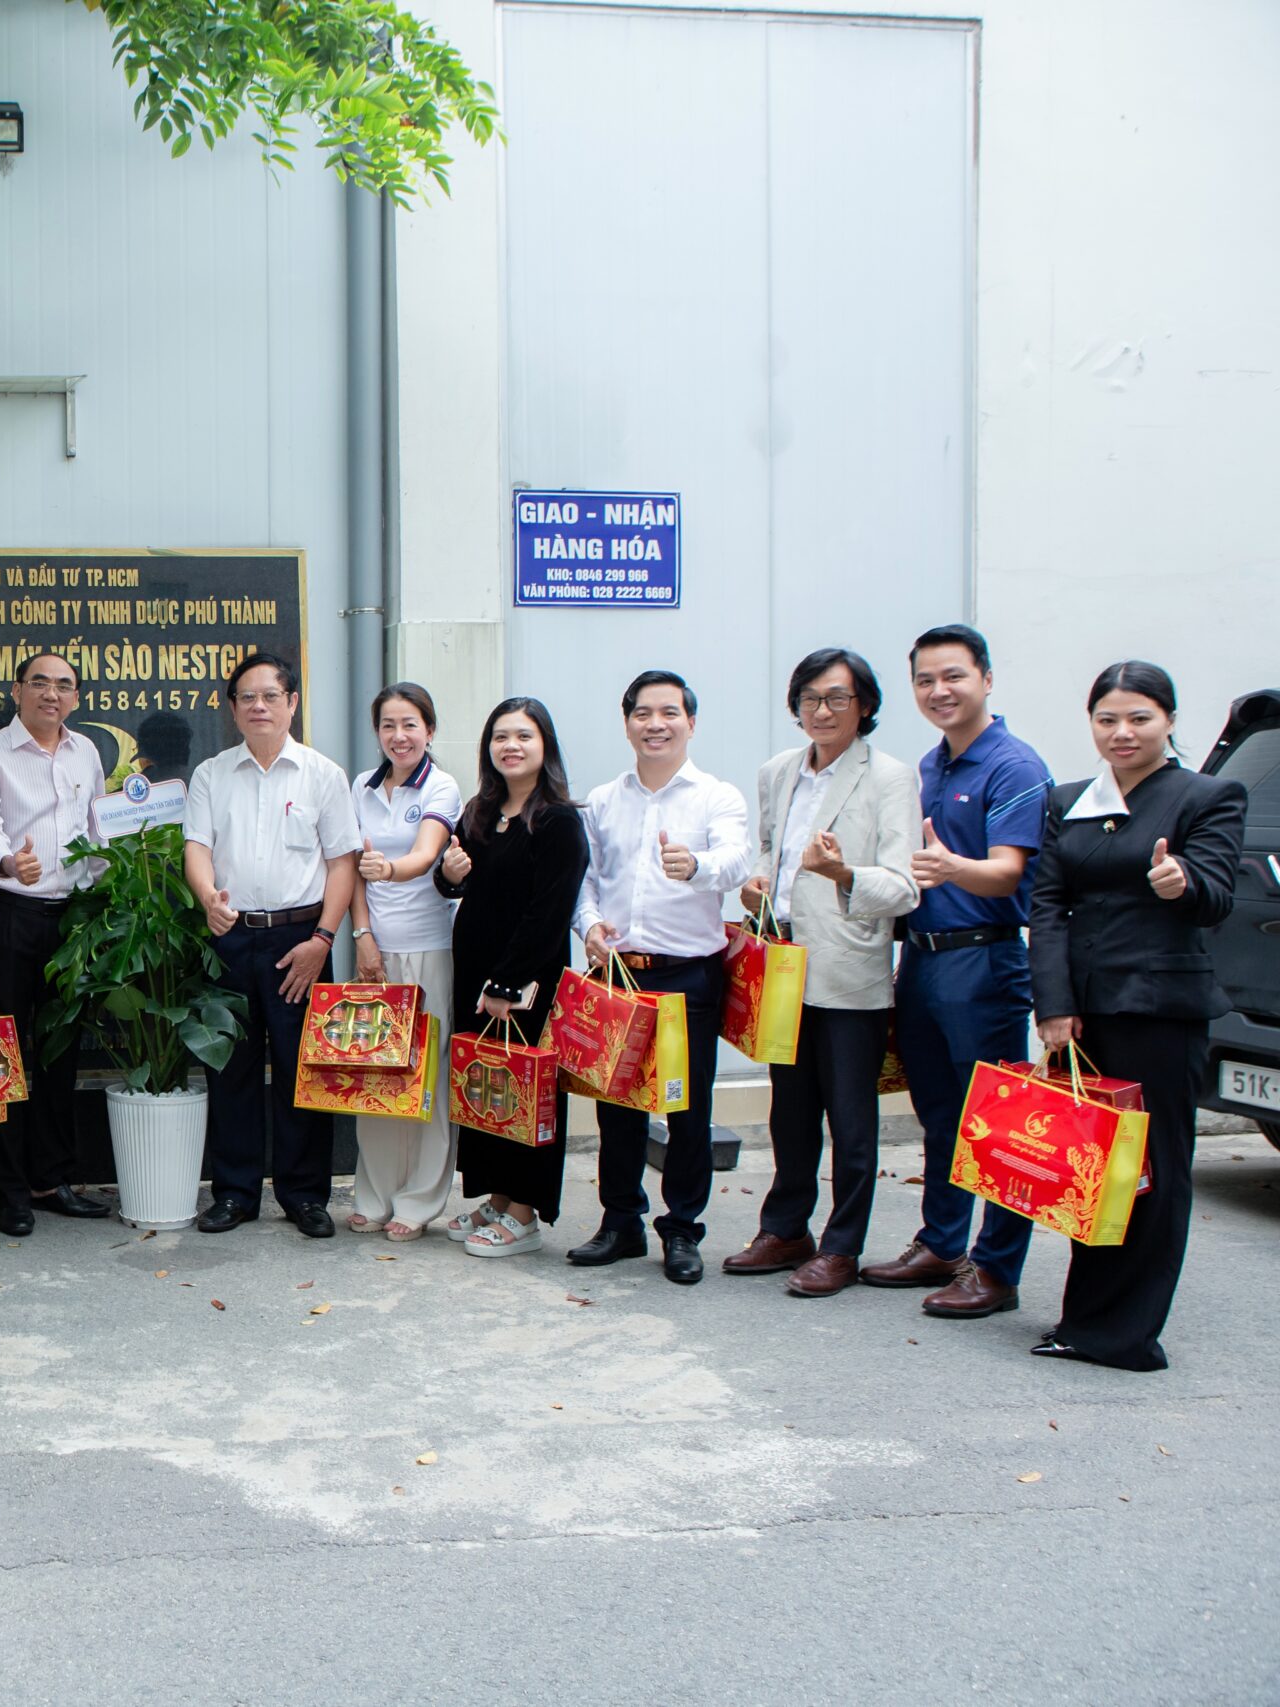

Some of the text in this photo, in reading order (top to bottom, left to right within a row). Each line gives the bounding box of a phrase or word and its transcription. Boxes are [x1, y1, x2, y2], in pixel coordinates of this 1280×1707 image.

[520, 502, 579, 524] GIAO
[604, 500, 674, 530] NHẬN
[534, 534, 662, 561] HÀNG HÓA
[6, 565, 24, 587] VÀ
[28, 562, 56, 587] ĐẦU
[61, 567, 81, 587] TƯ
[547, 568, 573, 581] KHO:
[575, 569, 602, 581] 0846
[605, 569, 625, 582] 299
[523, 583, 546, 598] VĂN
[549, 583, 590, 598] PHÒNG:
[593, 586, 613, 598] 028
[616, 586, 643, 599] 2222
[10, 595, 56, 625] CÔNG
[61, 600, 82, 625] TY
[87, 600, 131, 625] TNHH
[136, 597, 180, 630] DƯỢC
[184, 595, 217, 625] PHÚ
[221, 595, 277, 625] THÀNH
[104, 637, 153, 681] SÀO
[72, 690, 220, 712] 15841574
